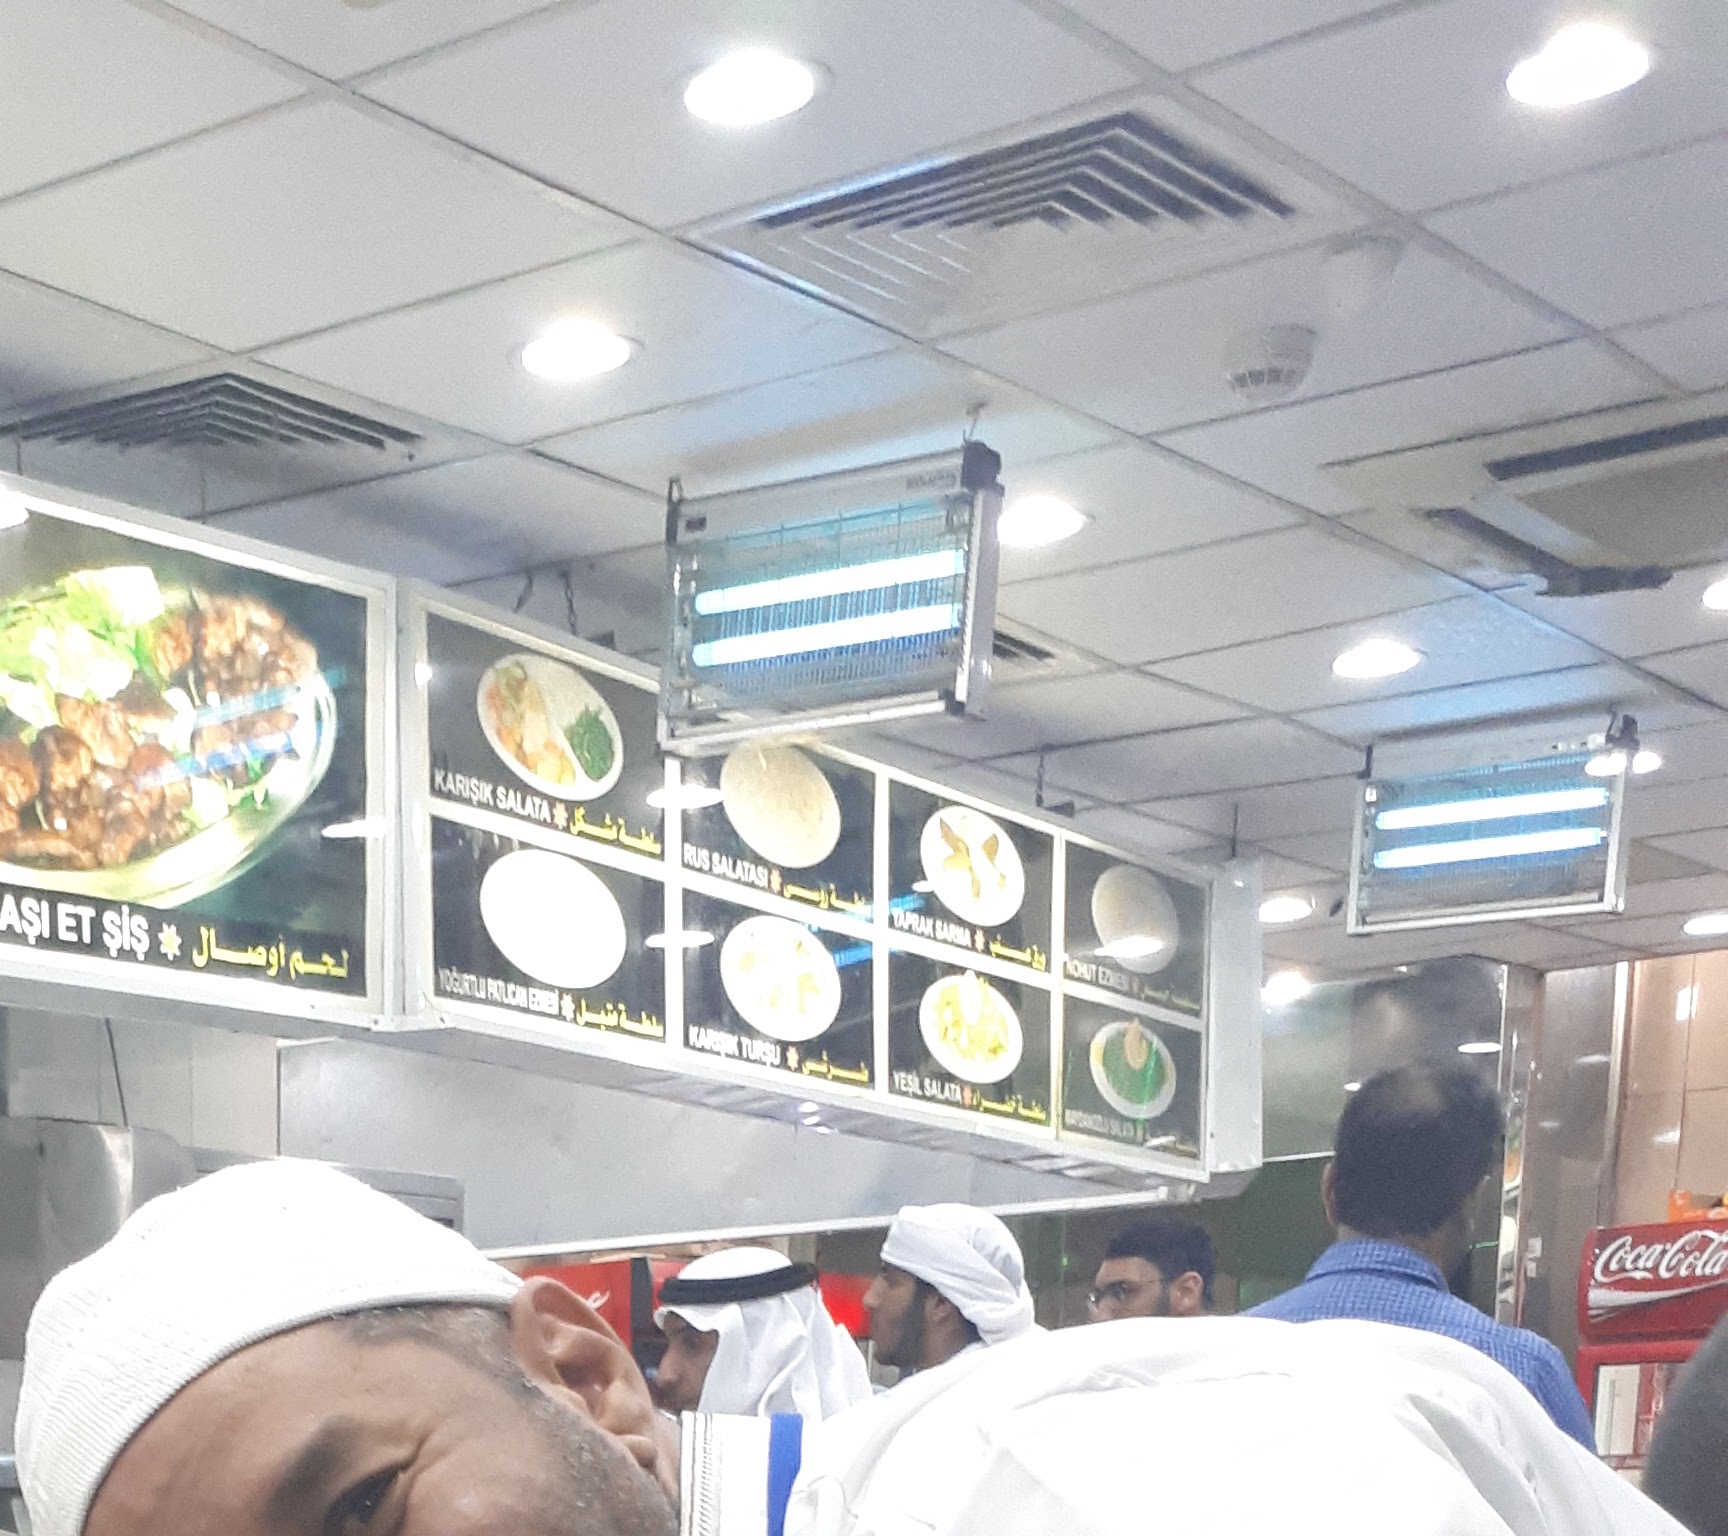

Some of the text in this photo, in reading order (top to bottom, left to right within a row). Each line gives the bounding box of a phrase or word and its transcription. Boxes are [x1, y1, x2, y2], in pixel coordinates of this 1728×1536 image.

[496, 785, 552, 824] SALATA
[683, 842, 710, 870] RUS
[57, 903, 96, 942] ET
[102, 904, 150, 960] ŞİŞ
[289, 947, 349, 981] لحم
[923, 1077, 963, 1105] SALATA
